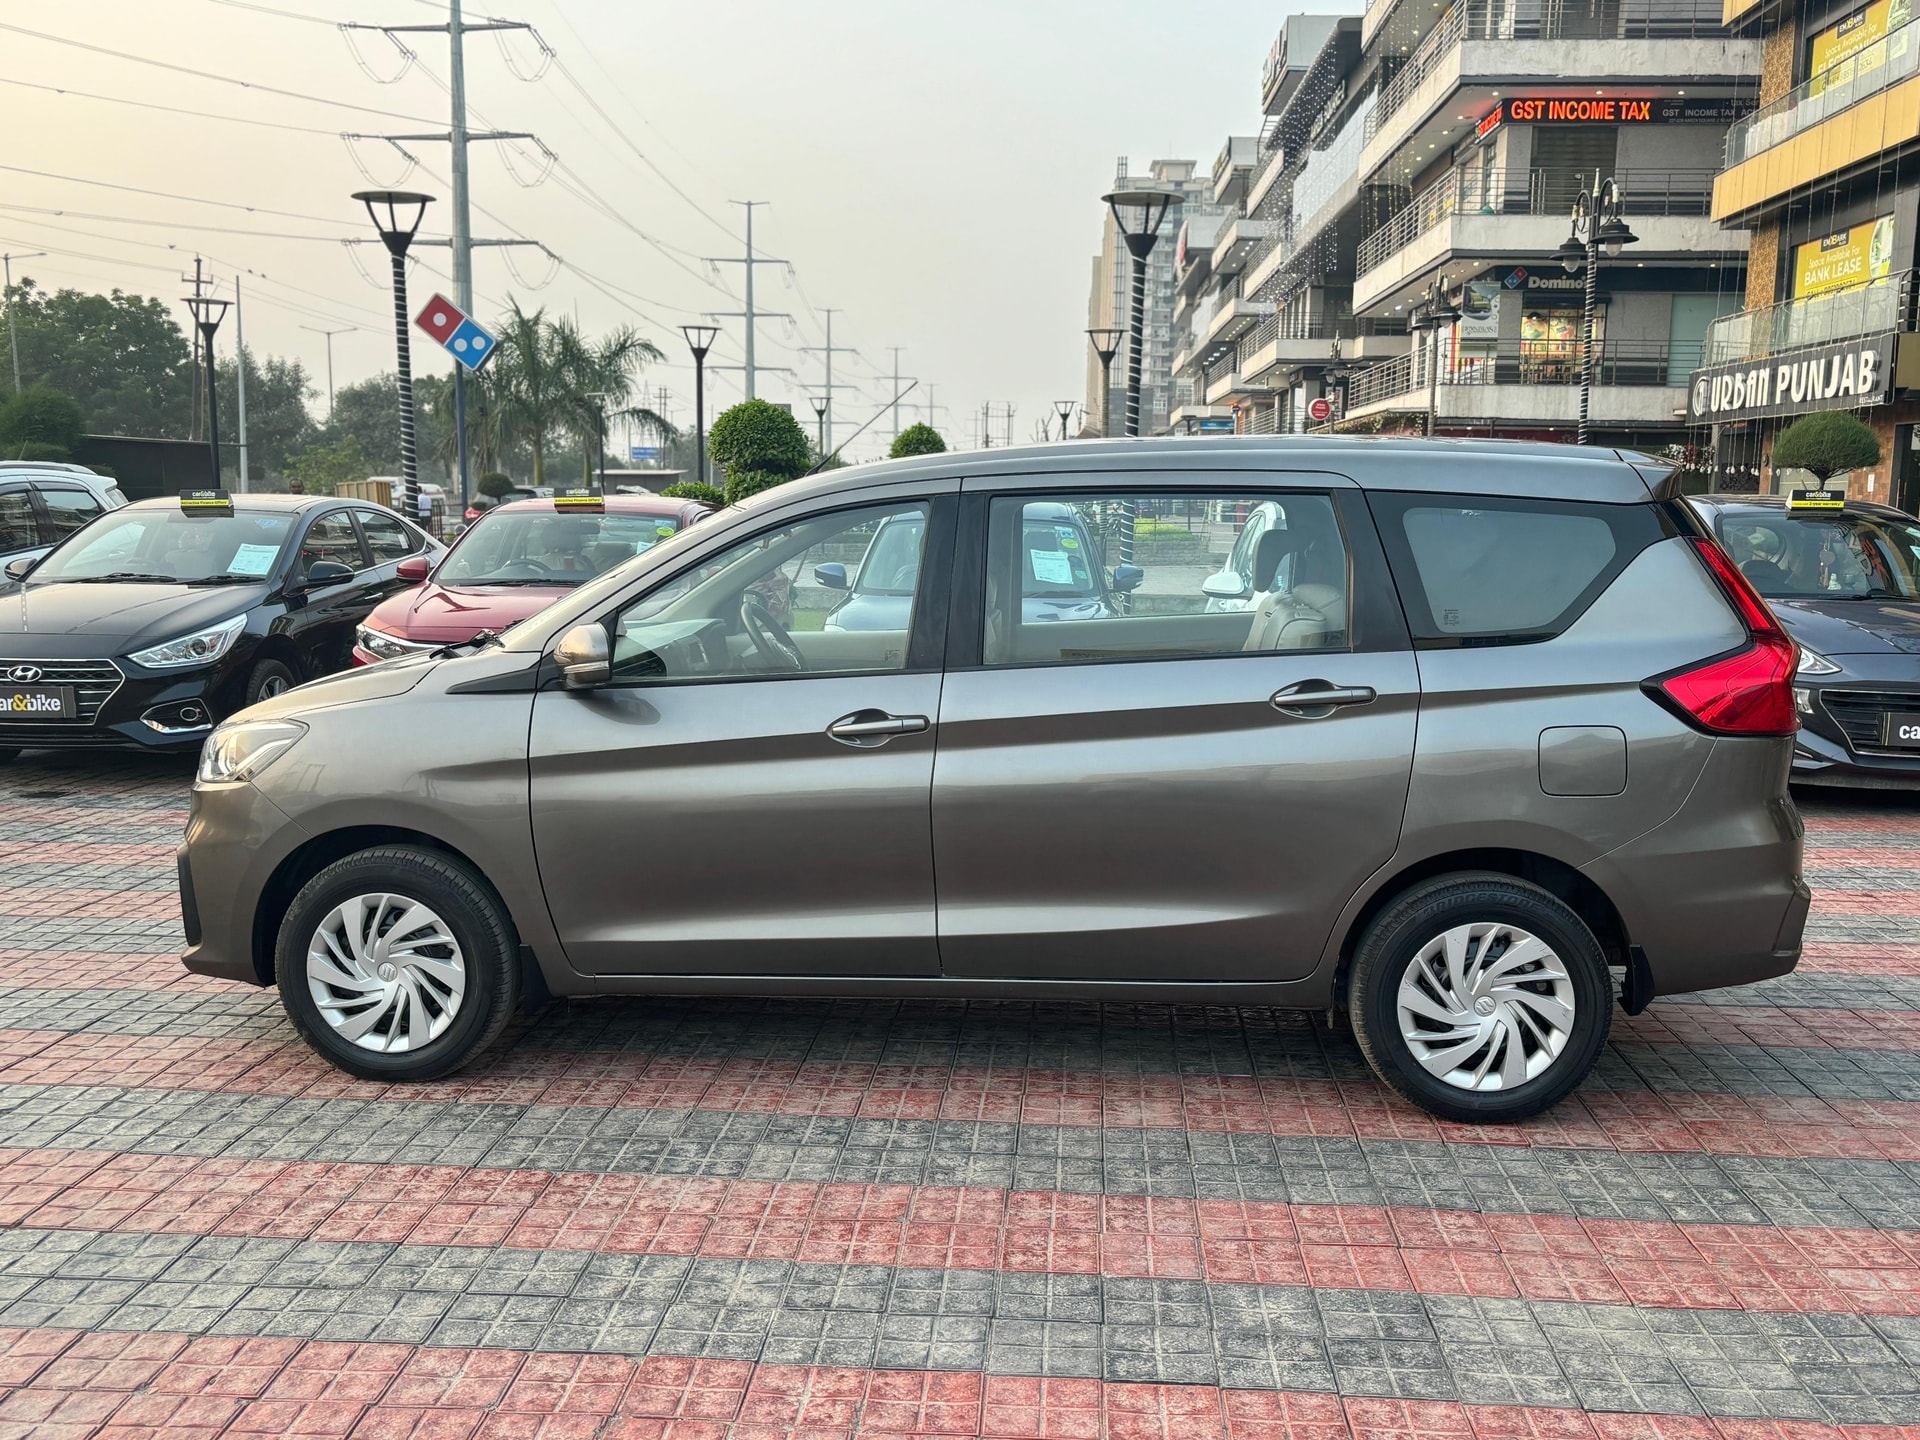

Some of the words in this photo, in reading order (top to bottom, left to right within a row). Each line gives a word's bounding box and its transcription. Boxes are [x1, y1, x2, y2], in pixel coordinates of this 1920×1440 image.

[1511, 101, 1545, 120] GST
[1549, 101, 1614, 120] INCOME
[1619, 101, 1651, 120] TAX
[1662, 109, 1680, 117] GST
[1685, 109, 1718, 117] INCOME
[1720, 109, 1735, 117] TAX
[1808, 258, 1825, 269] Space
[1826, 250, 1850, 263] Available
[1851, 245, 1861, 256] For
[1804, 265, 1830, 287] BANK
[1831, 256, 1863, 278] LEASE
[1710, 367, 1770, 413] URBAN
[1775, 350, 1876, 404] PUNJAB
[1423, 891, 1544, 917] BRIDGESTONE
